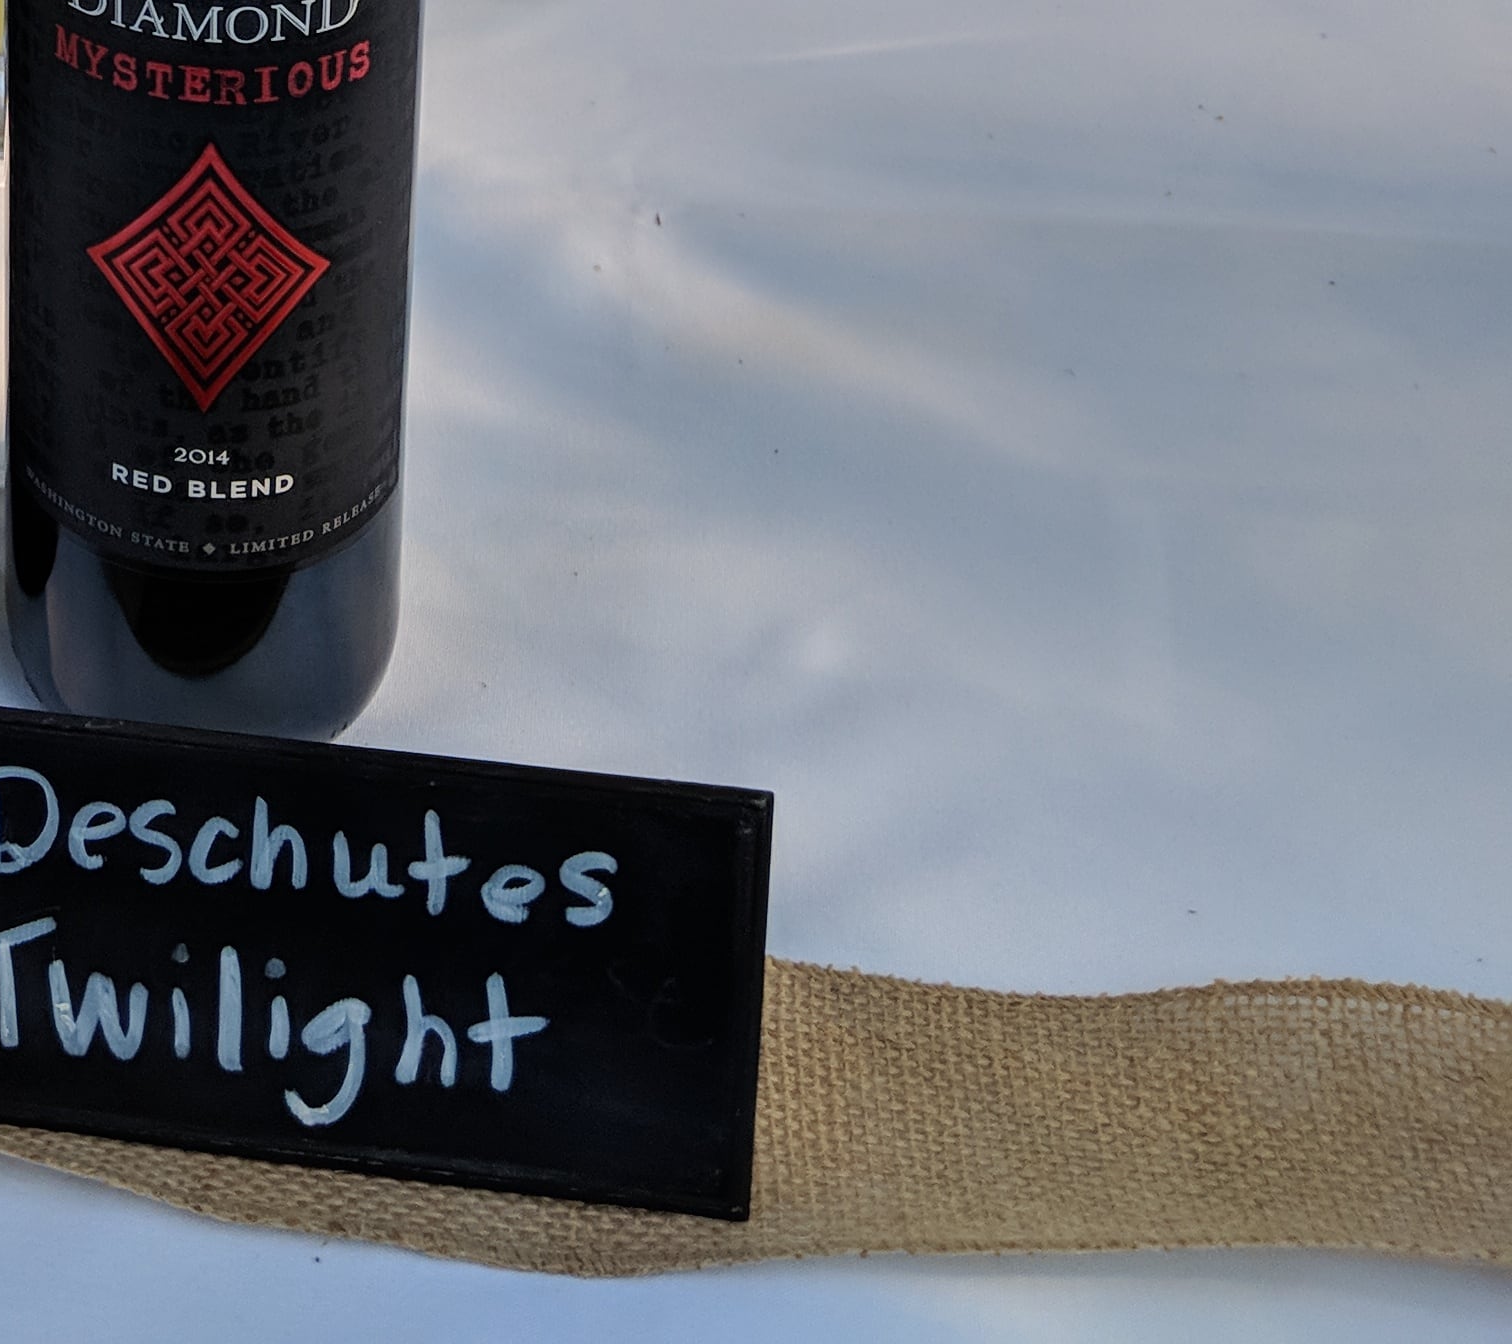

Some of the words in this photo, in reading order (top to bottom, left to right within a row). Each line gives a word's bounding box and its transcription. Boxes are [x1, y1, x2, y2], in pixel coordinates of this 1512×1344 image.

[54, 23, 372, 106] MYSTERIOUS
[111, 462, 173, 495] RED
[187, 473, 296, 500] BLEND
[173, 447, 231, 466] 2014
[130, 530, 191, 554] STATE
[229, 527, 315, 556] LIMITED
[320, 487, 383, 536] RELEASE
